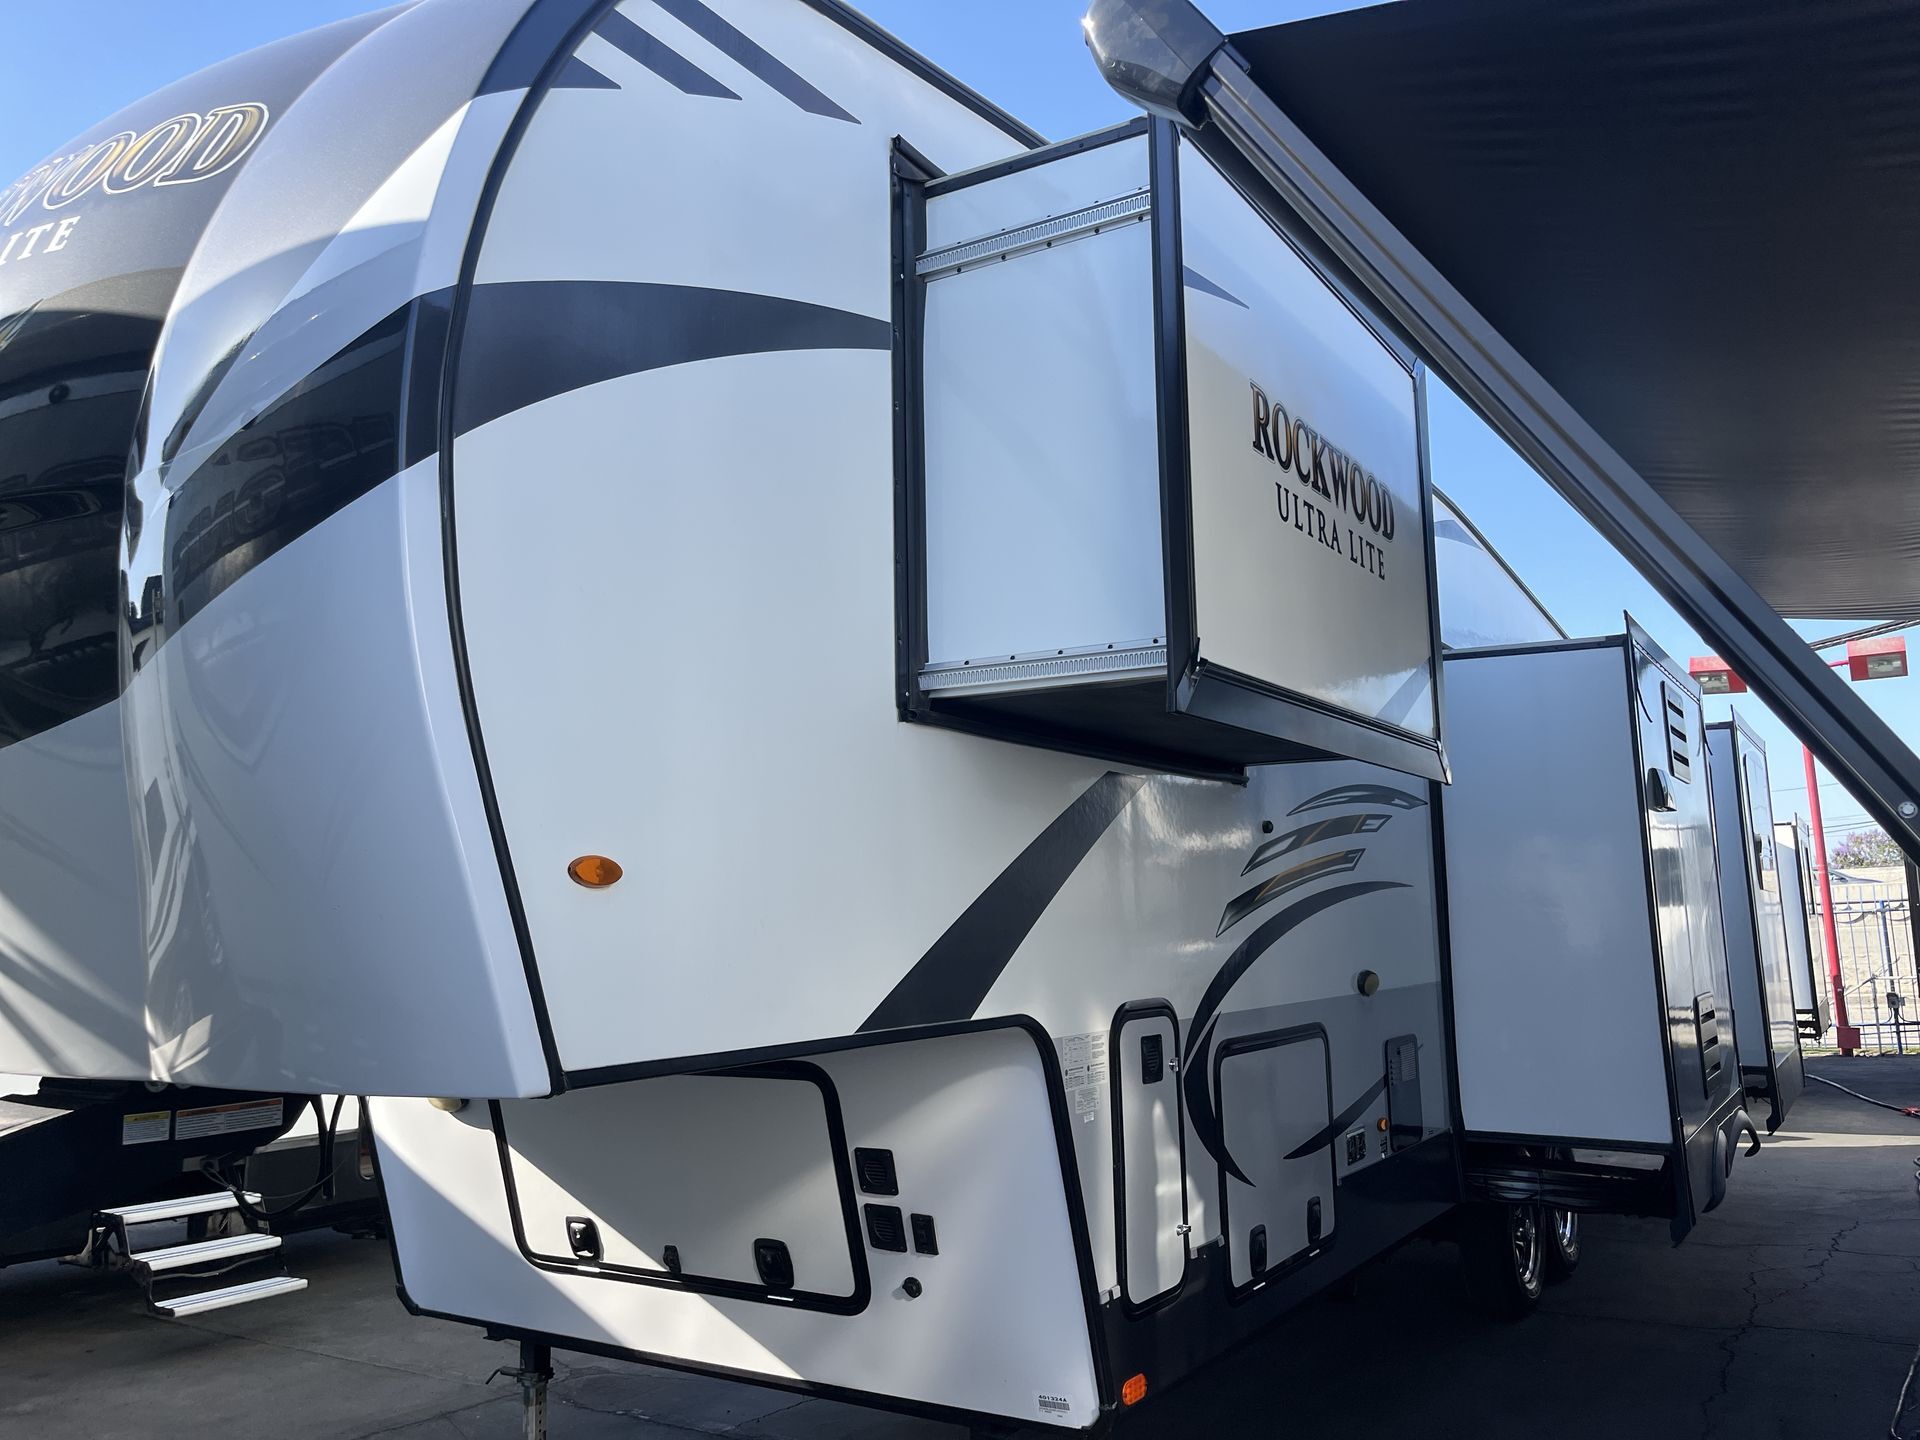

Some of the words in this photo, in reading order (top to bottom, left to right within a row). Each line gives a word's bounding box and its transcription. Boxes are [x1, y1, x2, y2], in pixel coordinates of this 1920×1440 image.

[1250, 378, 1395, 543] ROCKWOOD
[1275, 481, 1343, 555] ULTRA
[1348, 528, 1386, 580] LITE
